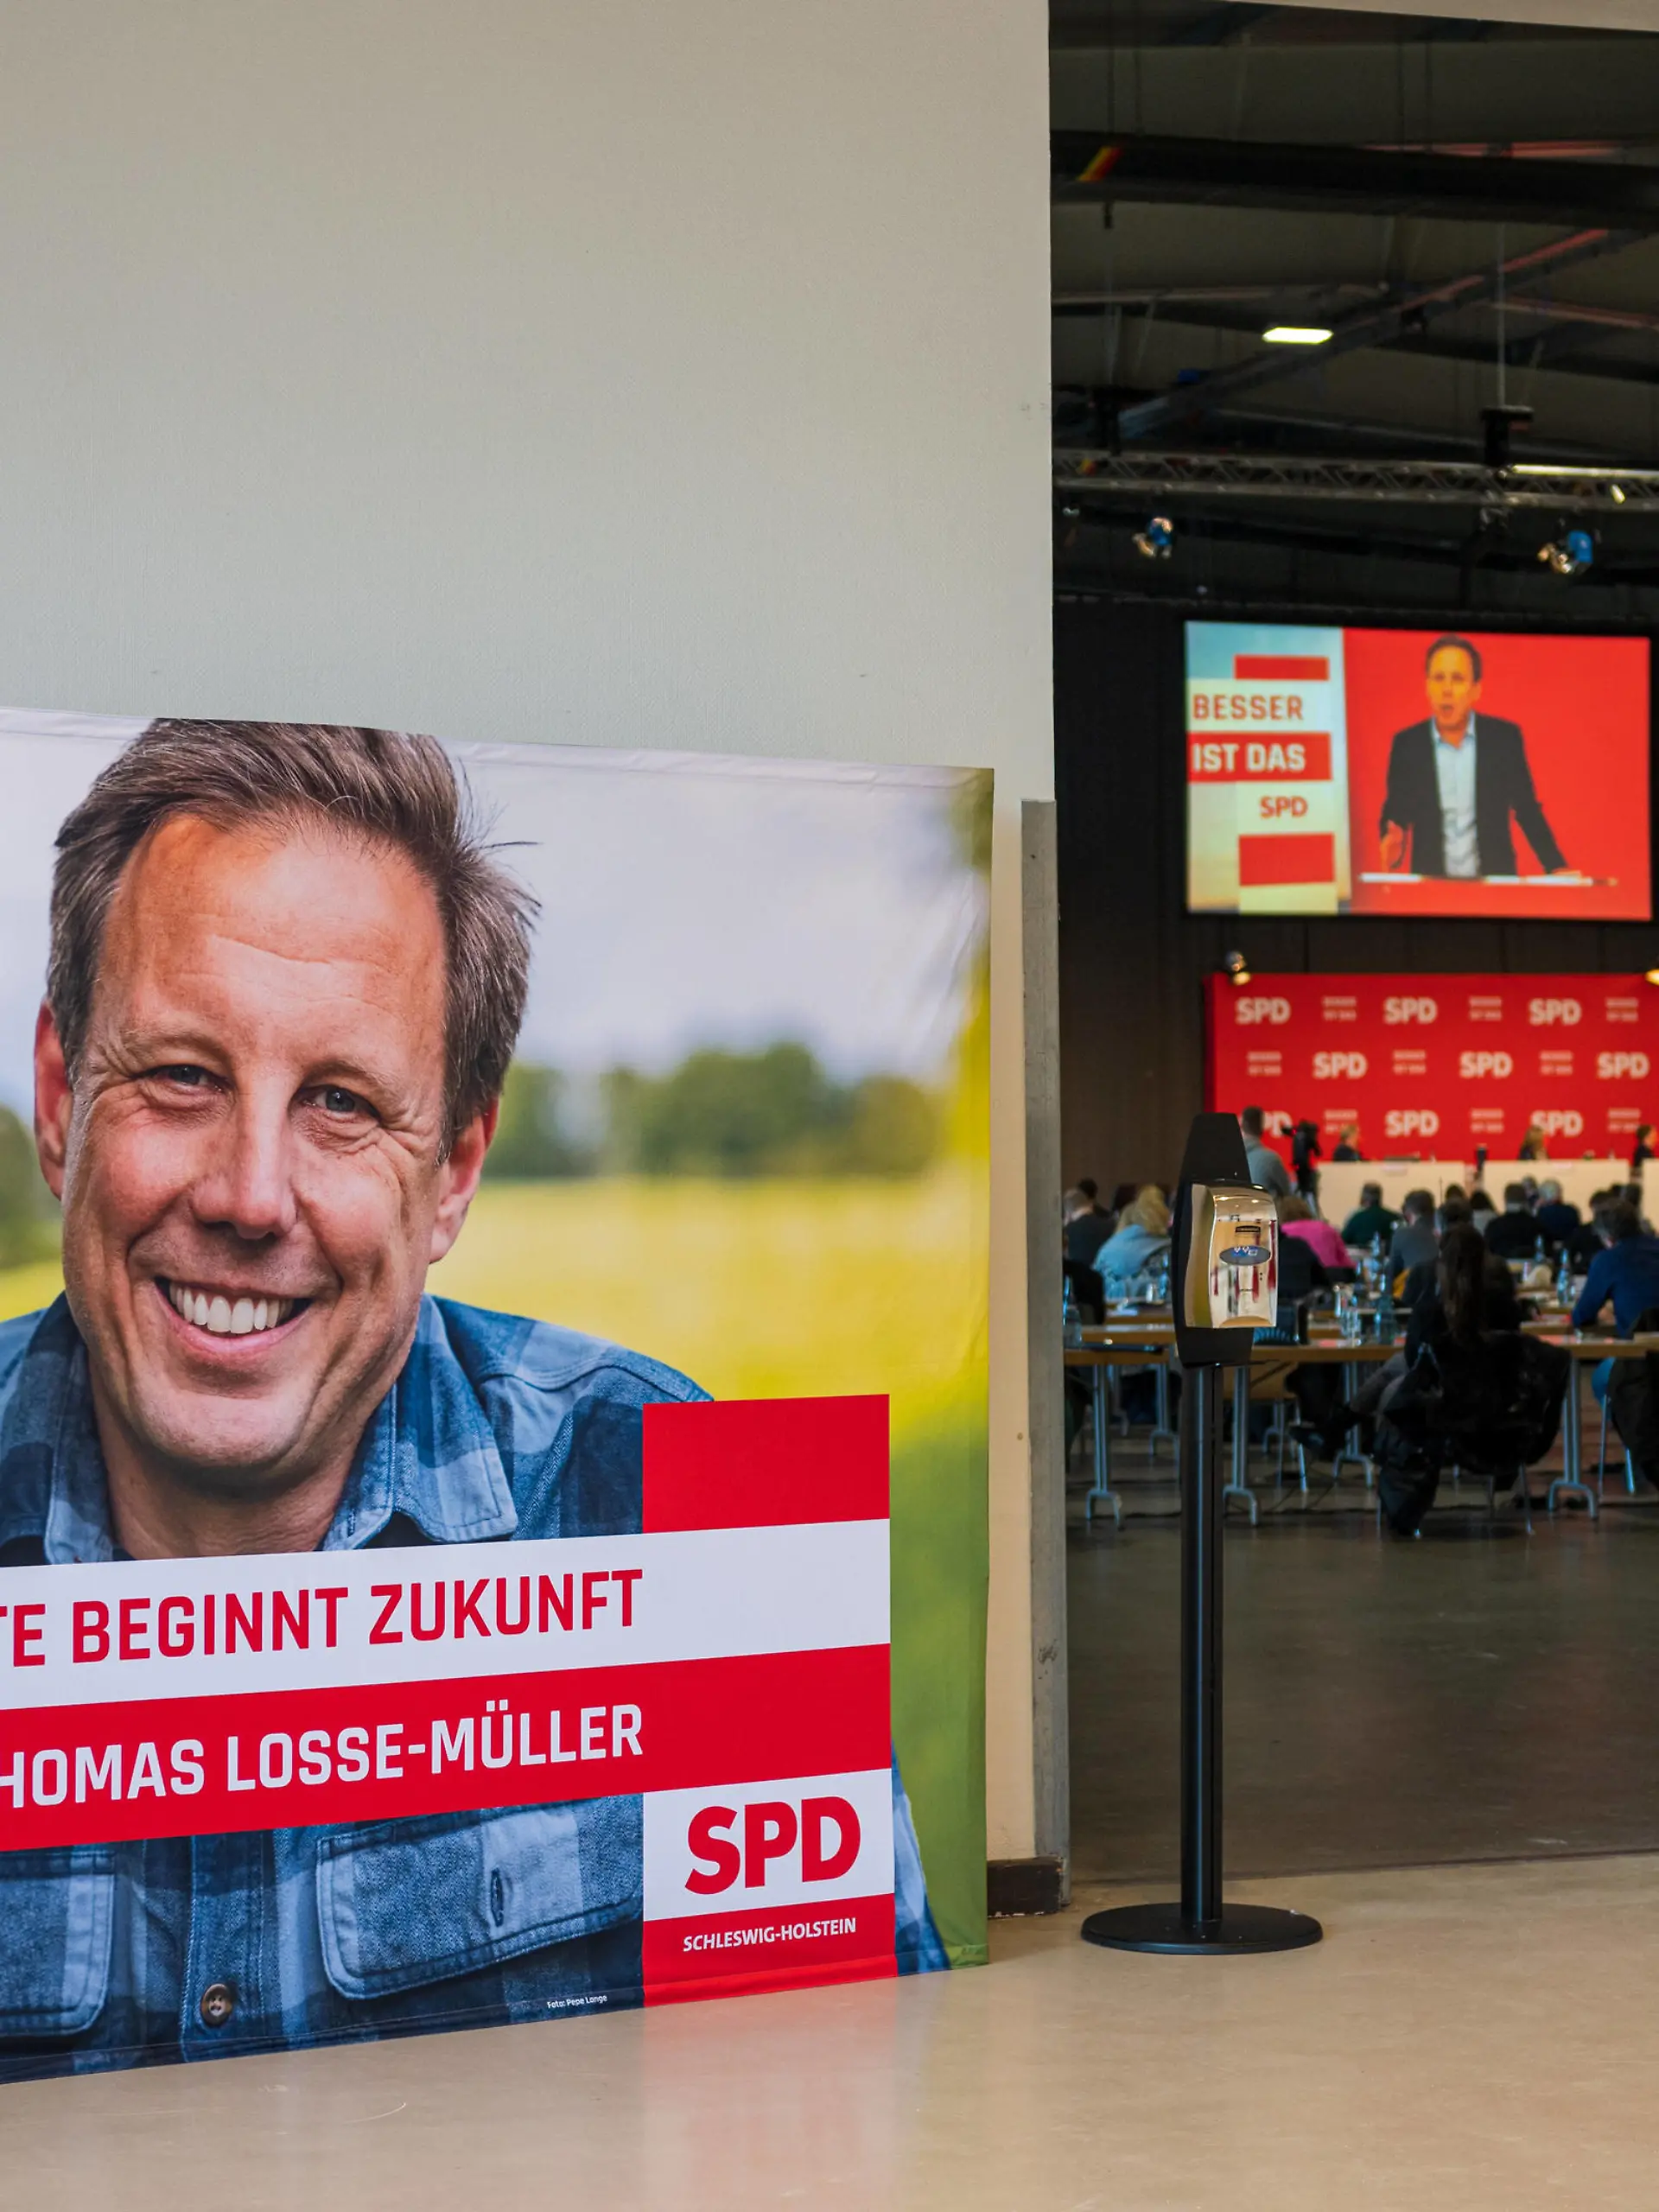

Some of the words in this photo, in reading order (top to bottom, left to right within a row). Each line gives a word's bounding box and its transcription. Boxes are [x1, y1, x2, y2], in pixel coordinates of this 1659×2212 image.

[1192, 694, 1303, 721] BESSER
[1192, 744, 1239, 772] IST
[1246, 743, 1306, 772] DAS
[1260, 796, 1308, 818] SPD
[1236, 998, 1290, 1024] SPD
[1384, 998, 1437, 1024] SPD
[1529, 999, 1581, 1026] SPD
[1313, 1052, 1367, 1079] SPD
[1459, 1052, 1513, 1078] SPD
[1596, 1052, 1649, 1079] SPD
[1384, 1109, 1440, 1138] SPD
[1531, 1109, 1584, 1137] SPD
[0, 1604, 46, 1668] E
[73, 1586, 349, 1664] BEGINNT
[368, 1568, 644, 1645] ZUKUNFT
[226, 1699, 644, 1792] LOSSE-MÜLLER
[684, 1796, 861, 1895] SPD
[683, 1916, 857, 1952] SCHLESWIG-HOLSTEIN
[546, 2000, 565, 2009] Foto:
[566, 1998, 585, 2007] Pepe
